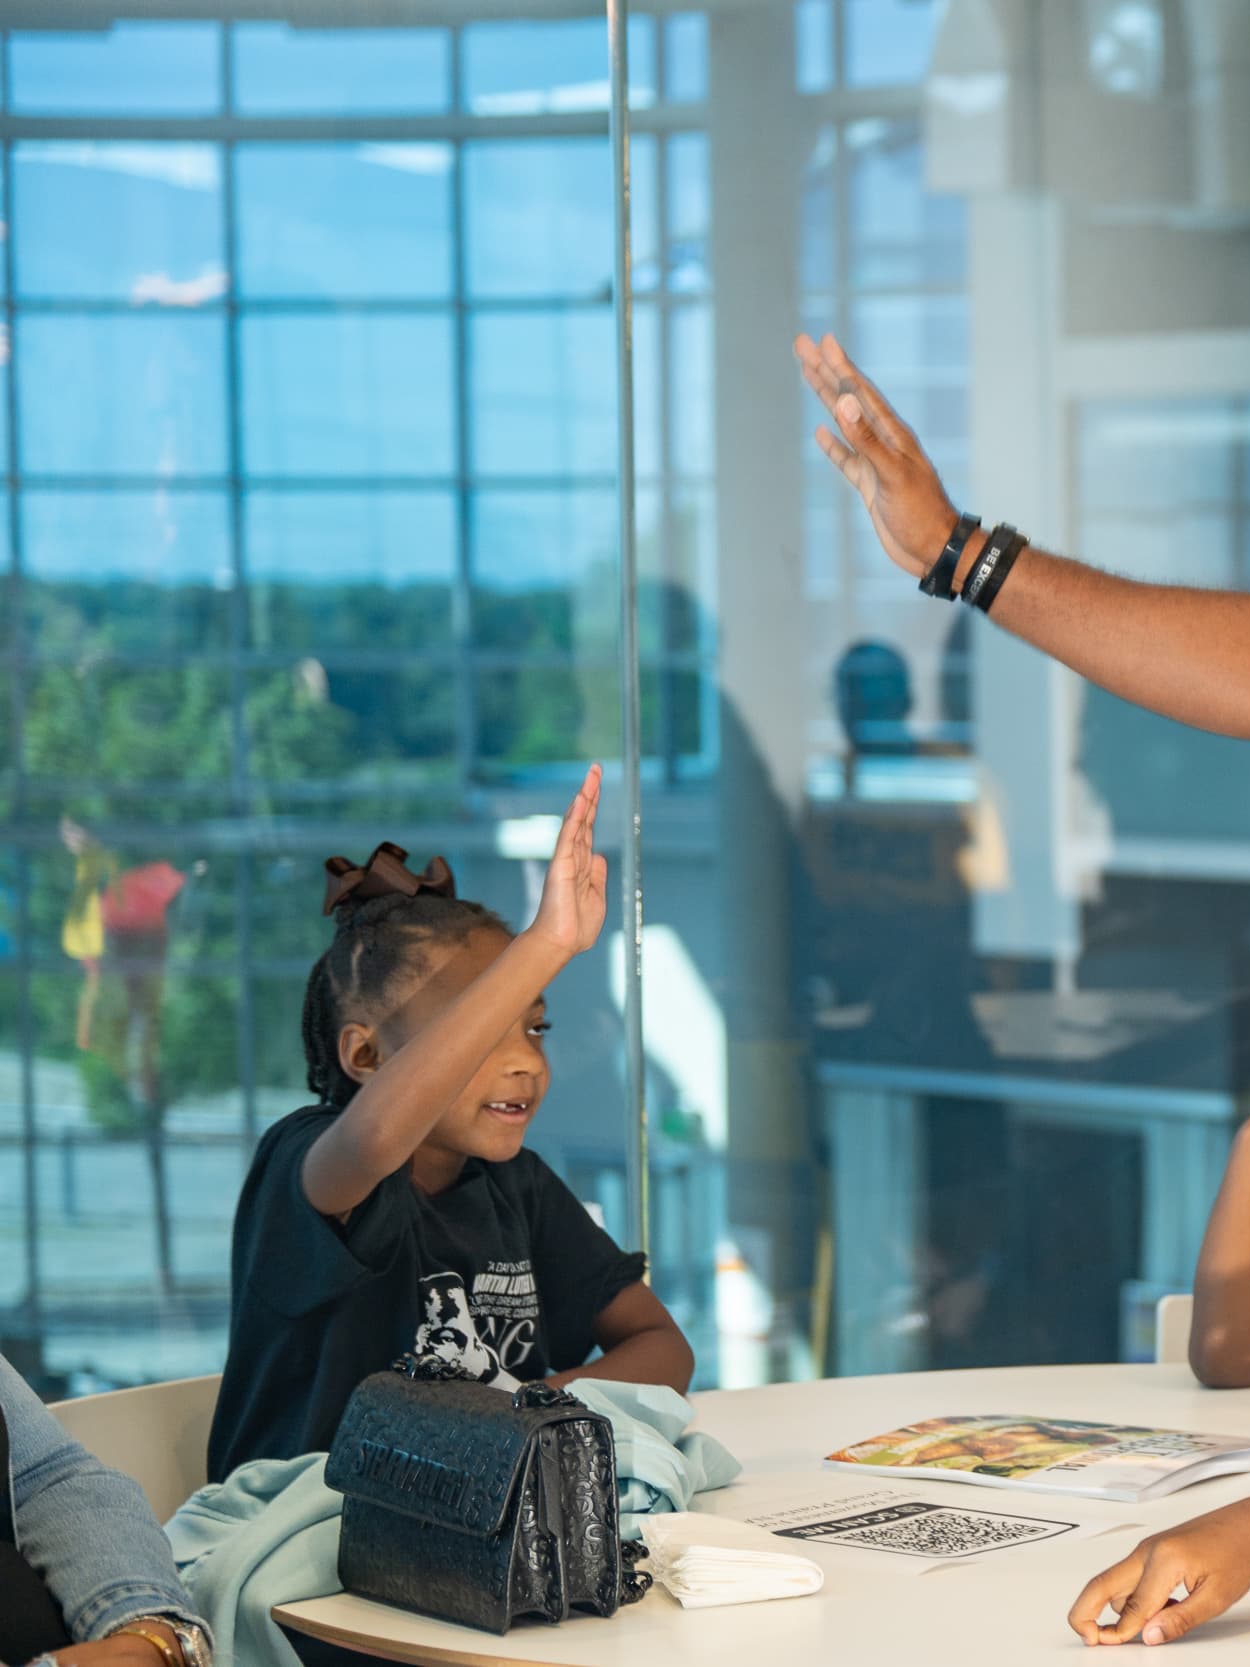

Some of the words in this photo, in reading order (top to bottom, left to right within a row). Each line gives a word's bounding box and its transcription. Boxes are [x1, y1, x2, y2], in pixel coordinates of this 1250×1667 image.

[986, 547, 1000, 565] BE
[832, 1511, 900, 1529] SCAN
[792, 1523, 838, 1536] ME
